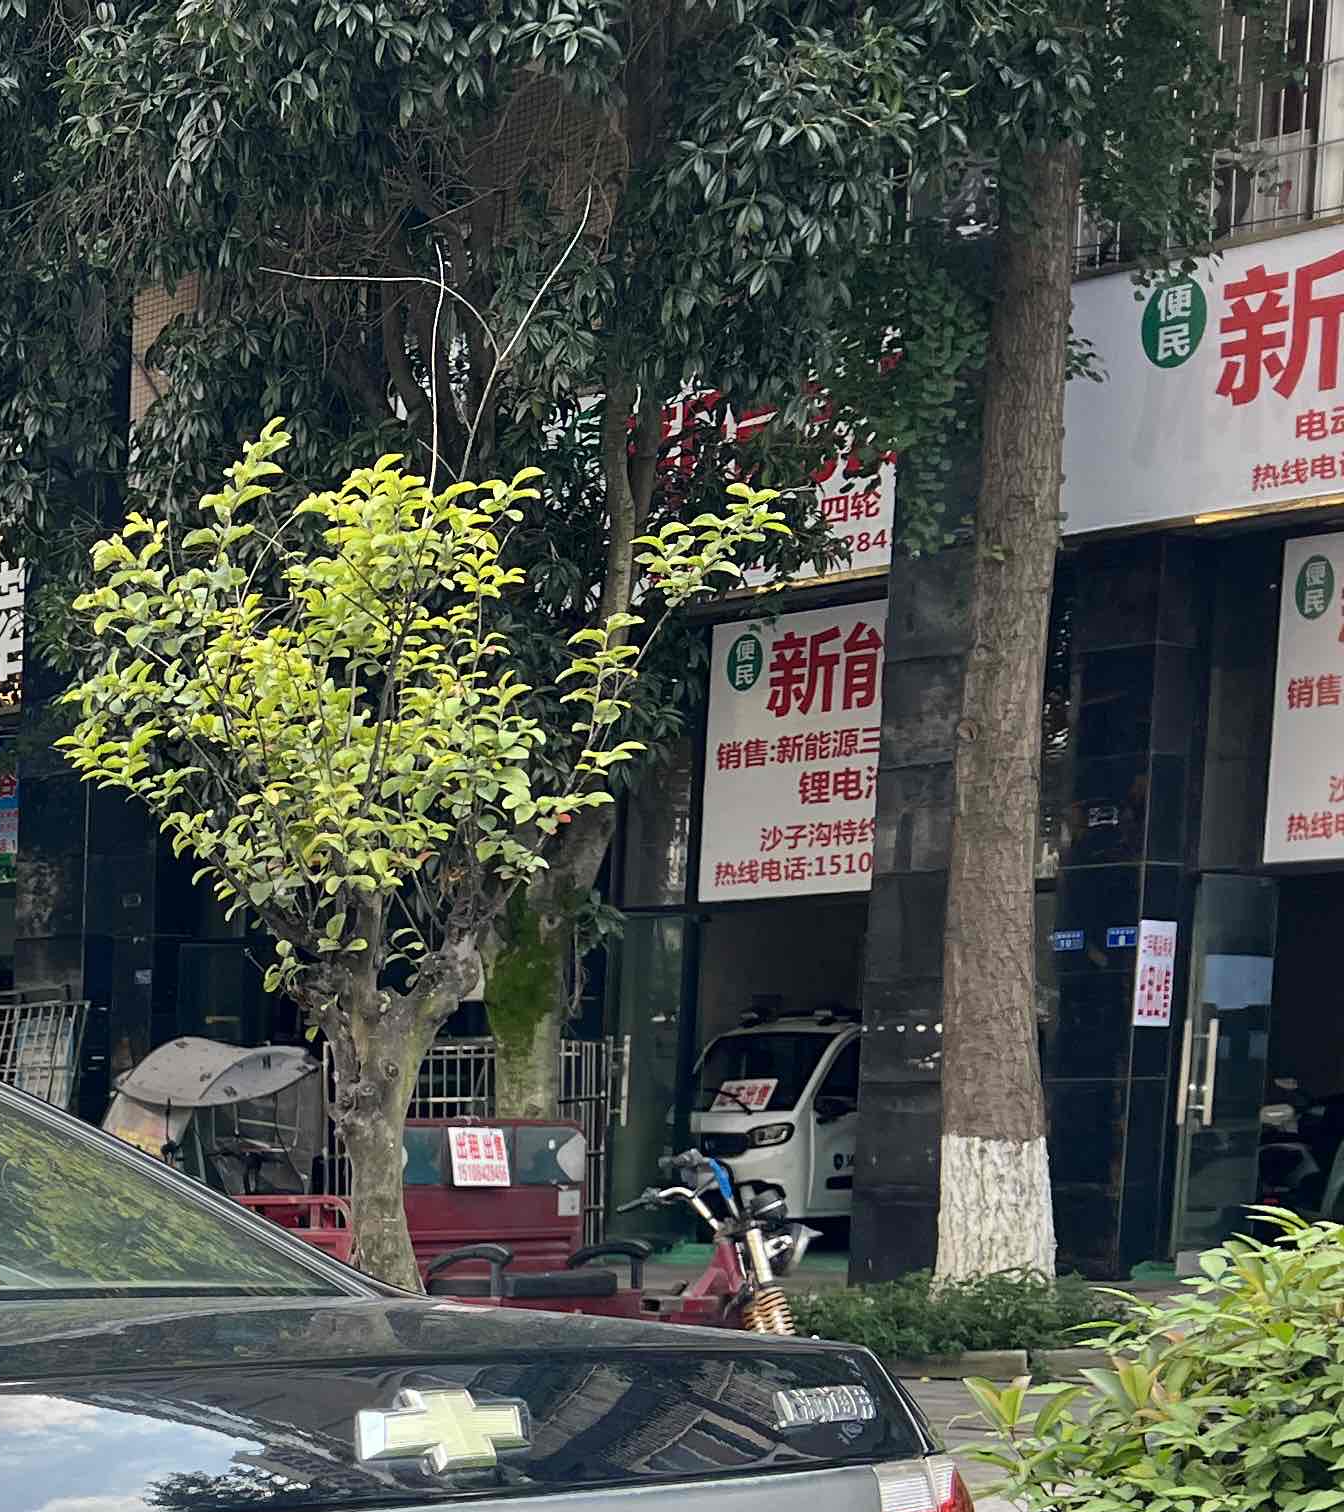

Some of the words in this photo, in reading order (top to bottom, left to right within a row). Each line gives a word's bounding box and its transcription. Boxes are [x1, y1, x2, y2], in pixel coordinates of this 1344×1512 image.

[1157, 284, 1193, 361] 便民
[1215, 250, 1344, 406] 新
[1252, 452, 1344, 491] 热线电
[821, 491, 881, 522] 四轮
[1305, 561, 1327, 613] 便民
[735, 640, 755, 686] 便民
[1287, 674, 1342, 709] 销售
